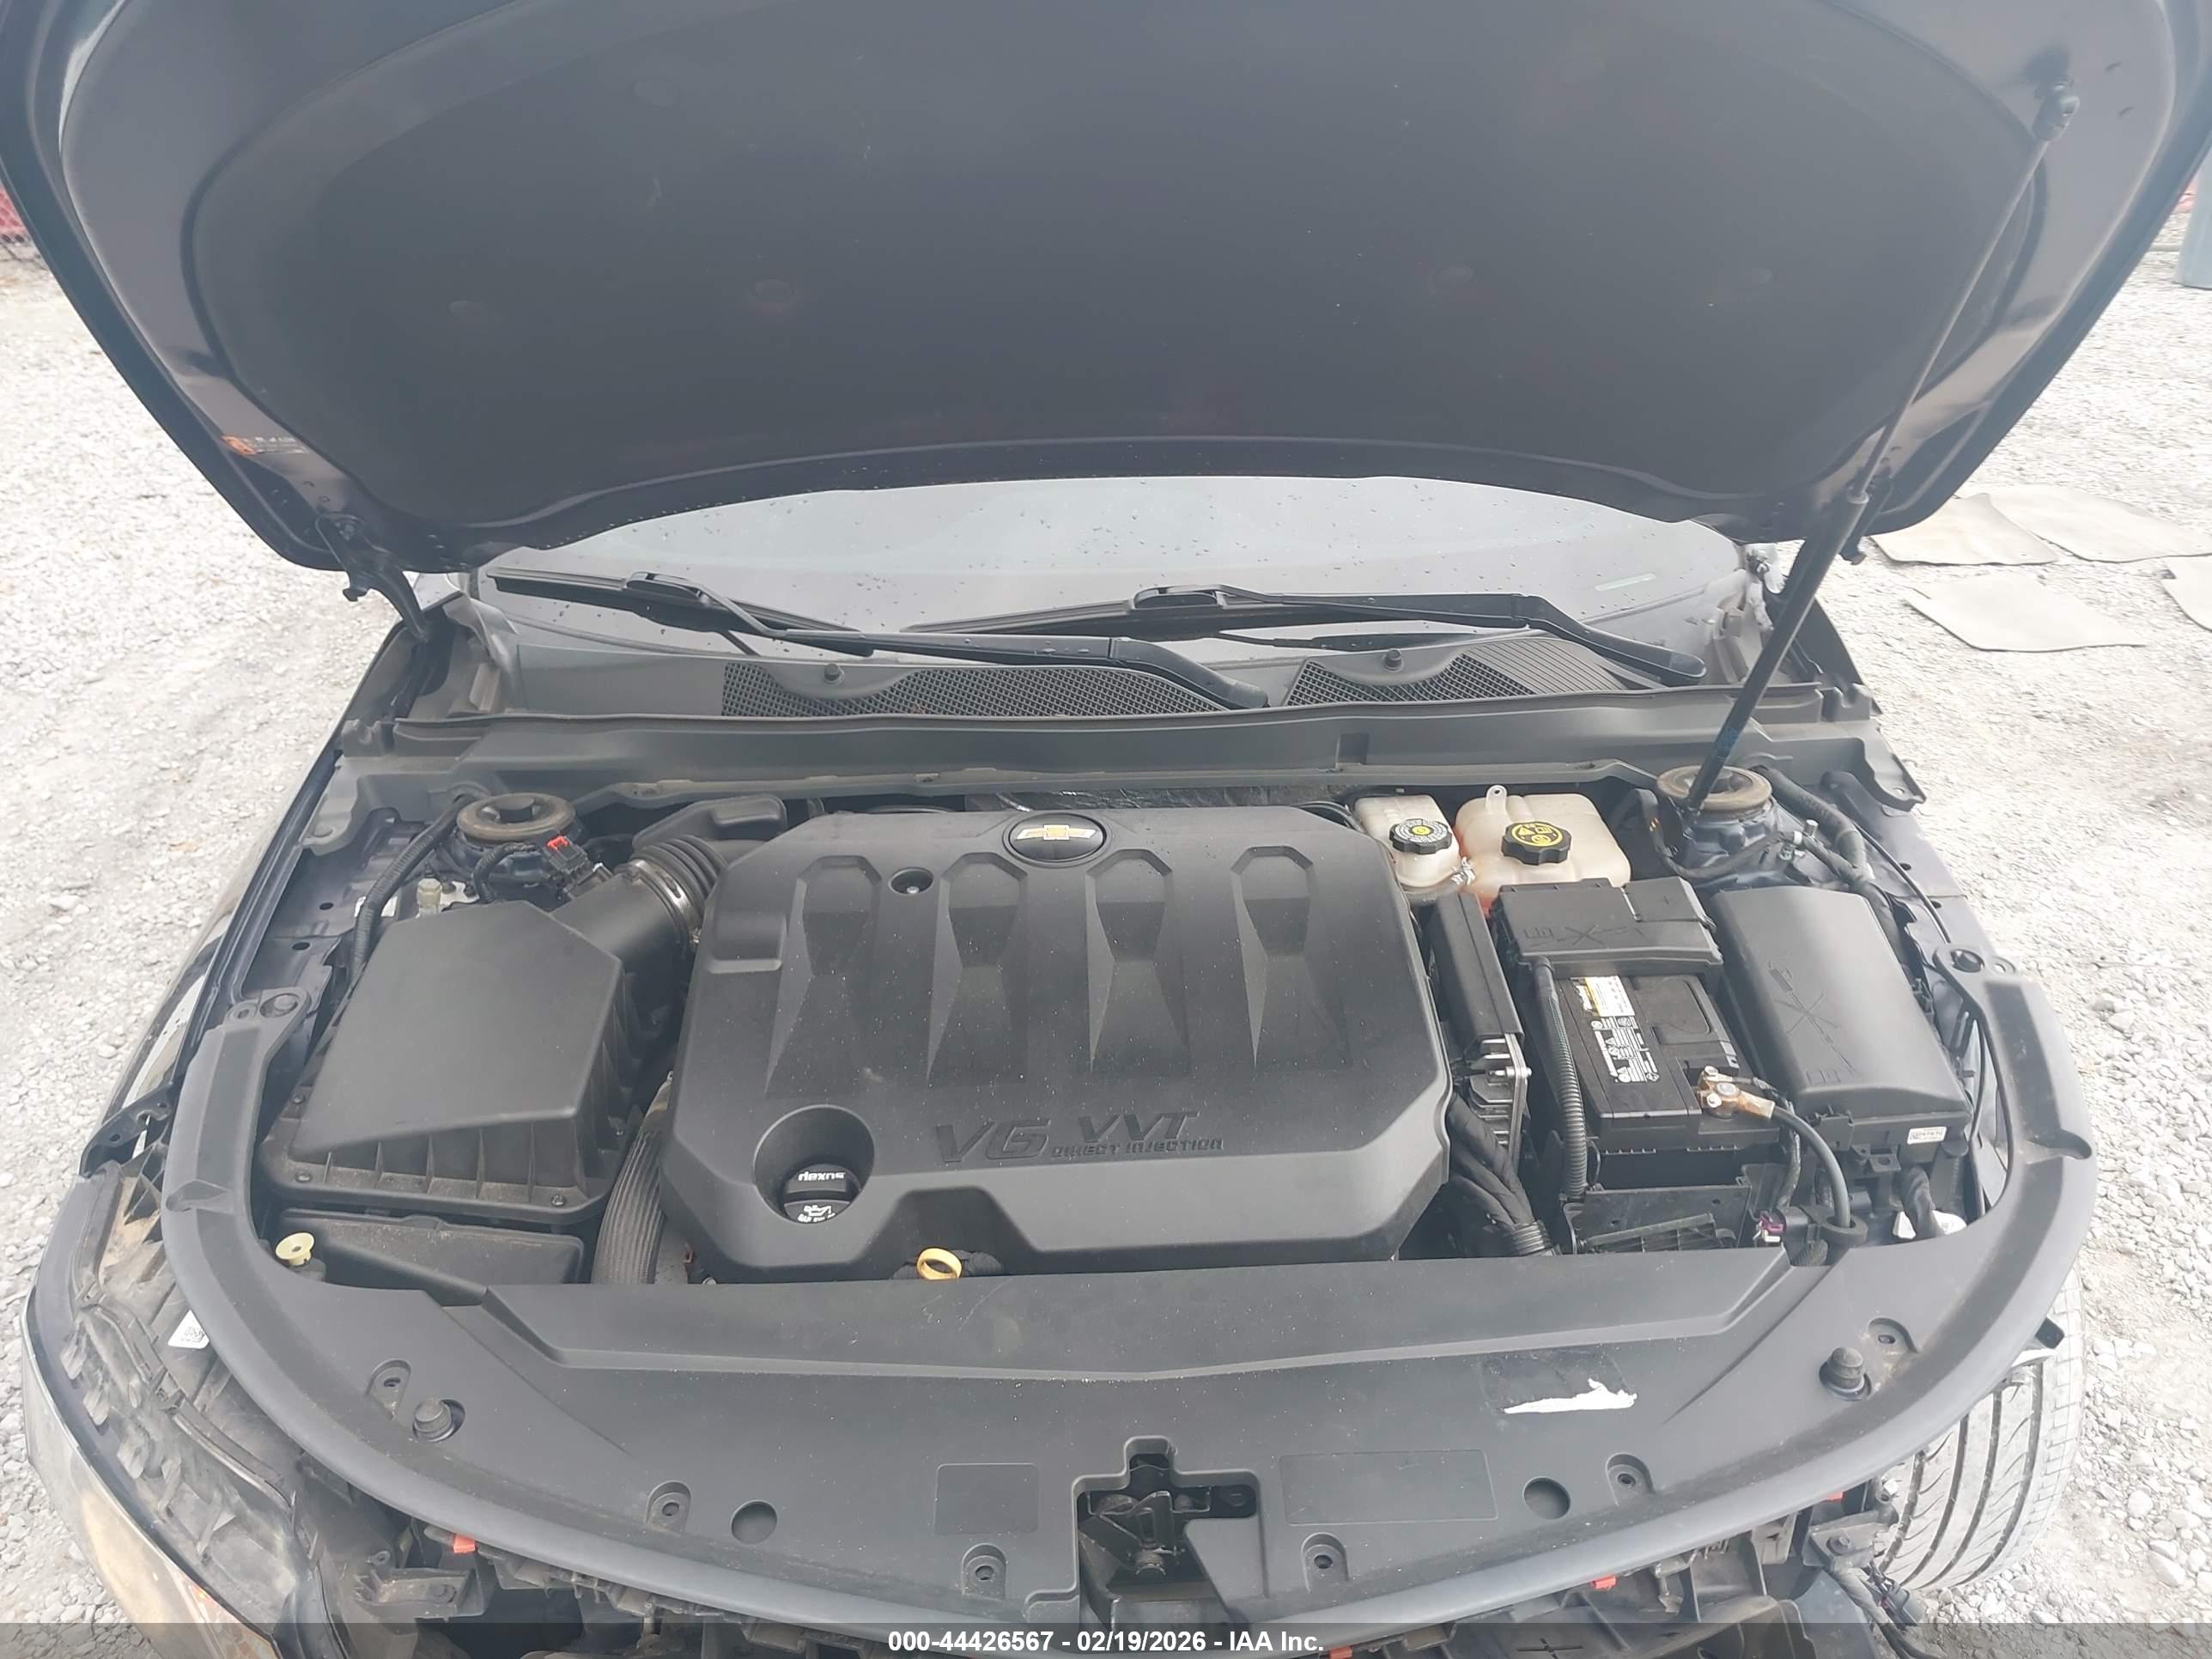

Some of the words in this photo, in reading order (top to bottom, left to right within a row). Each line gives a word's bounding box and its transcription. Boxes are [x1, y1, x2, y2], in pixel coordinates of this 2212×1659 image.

[936, 1120, 1051, 1164] V6
[1077, 1111, 1200, 1144] VVT
[1051, 1144, 1120, 1158] DIRECT
[1126, 1138, 1224, 1154] INJECTION
